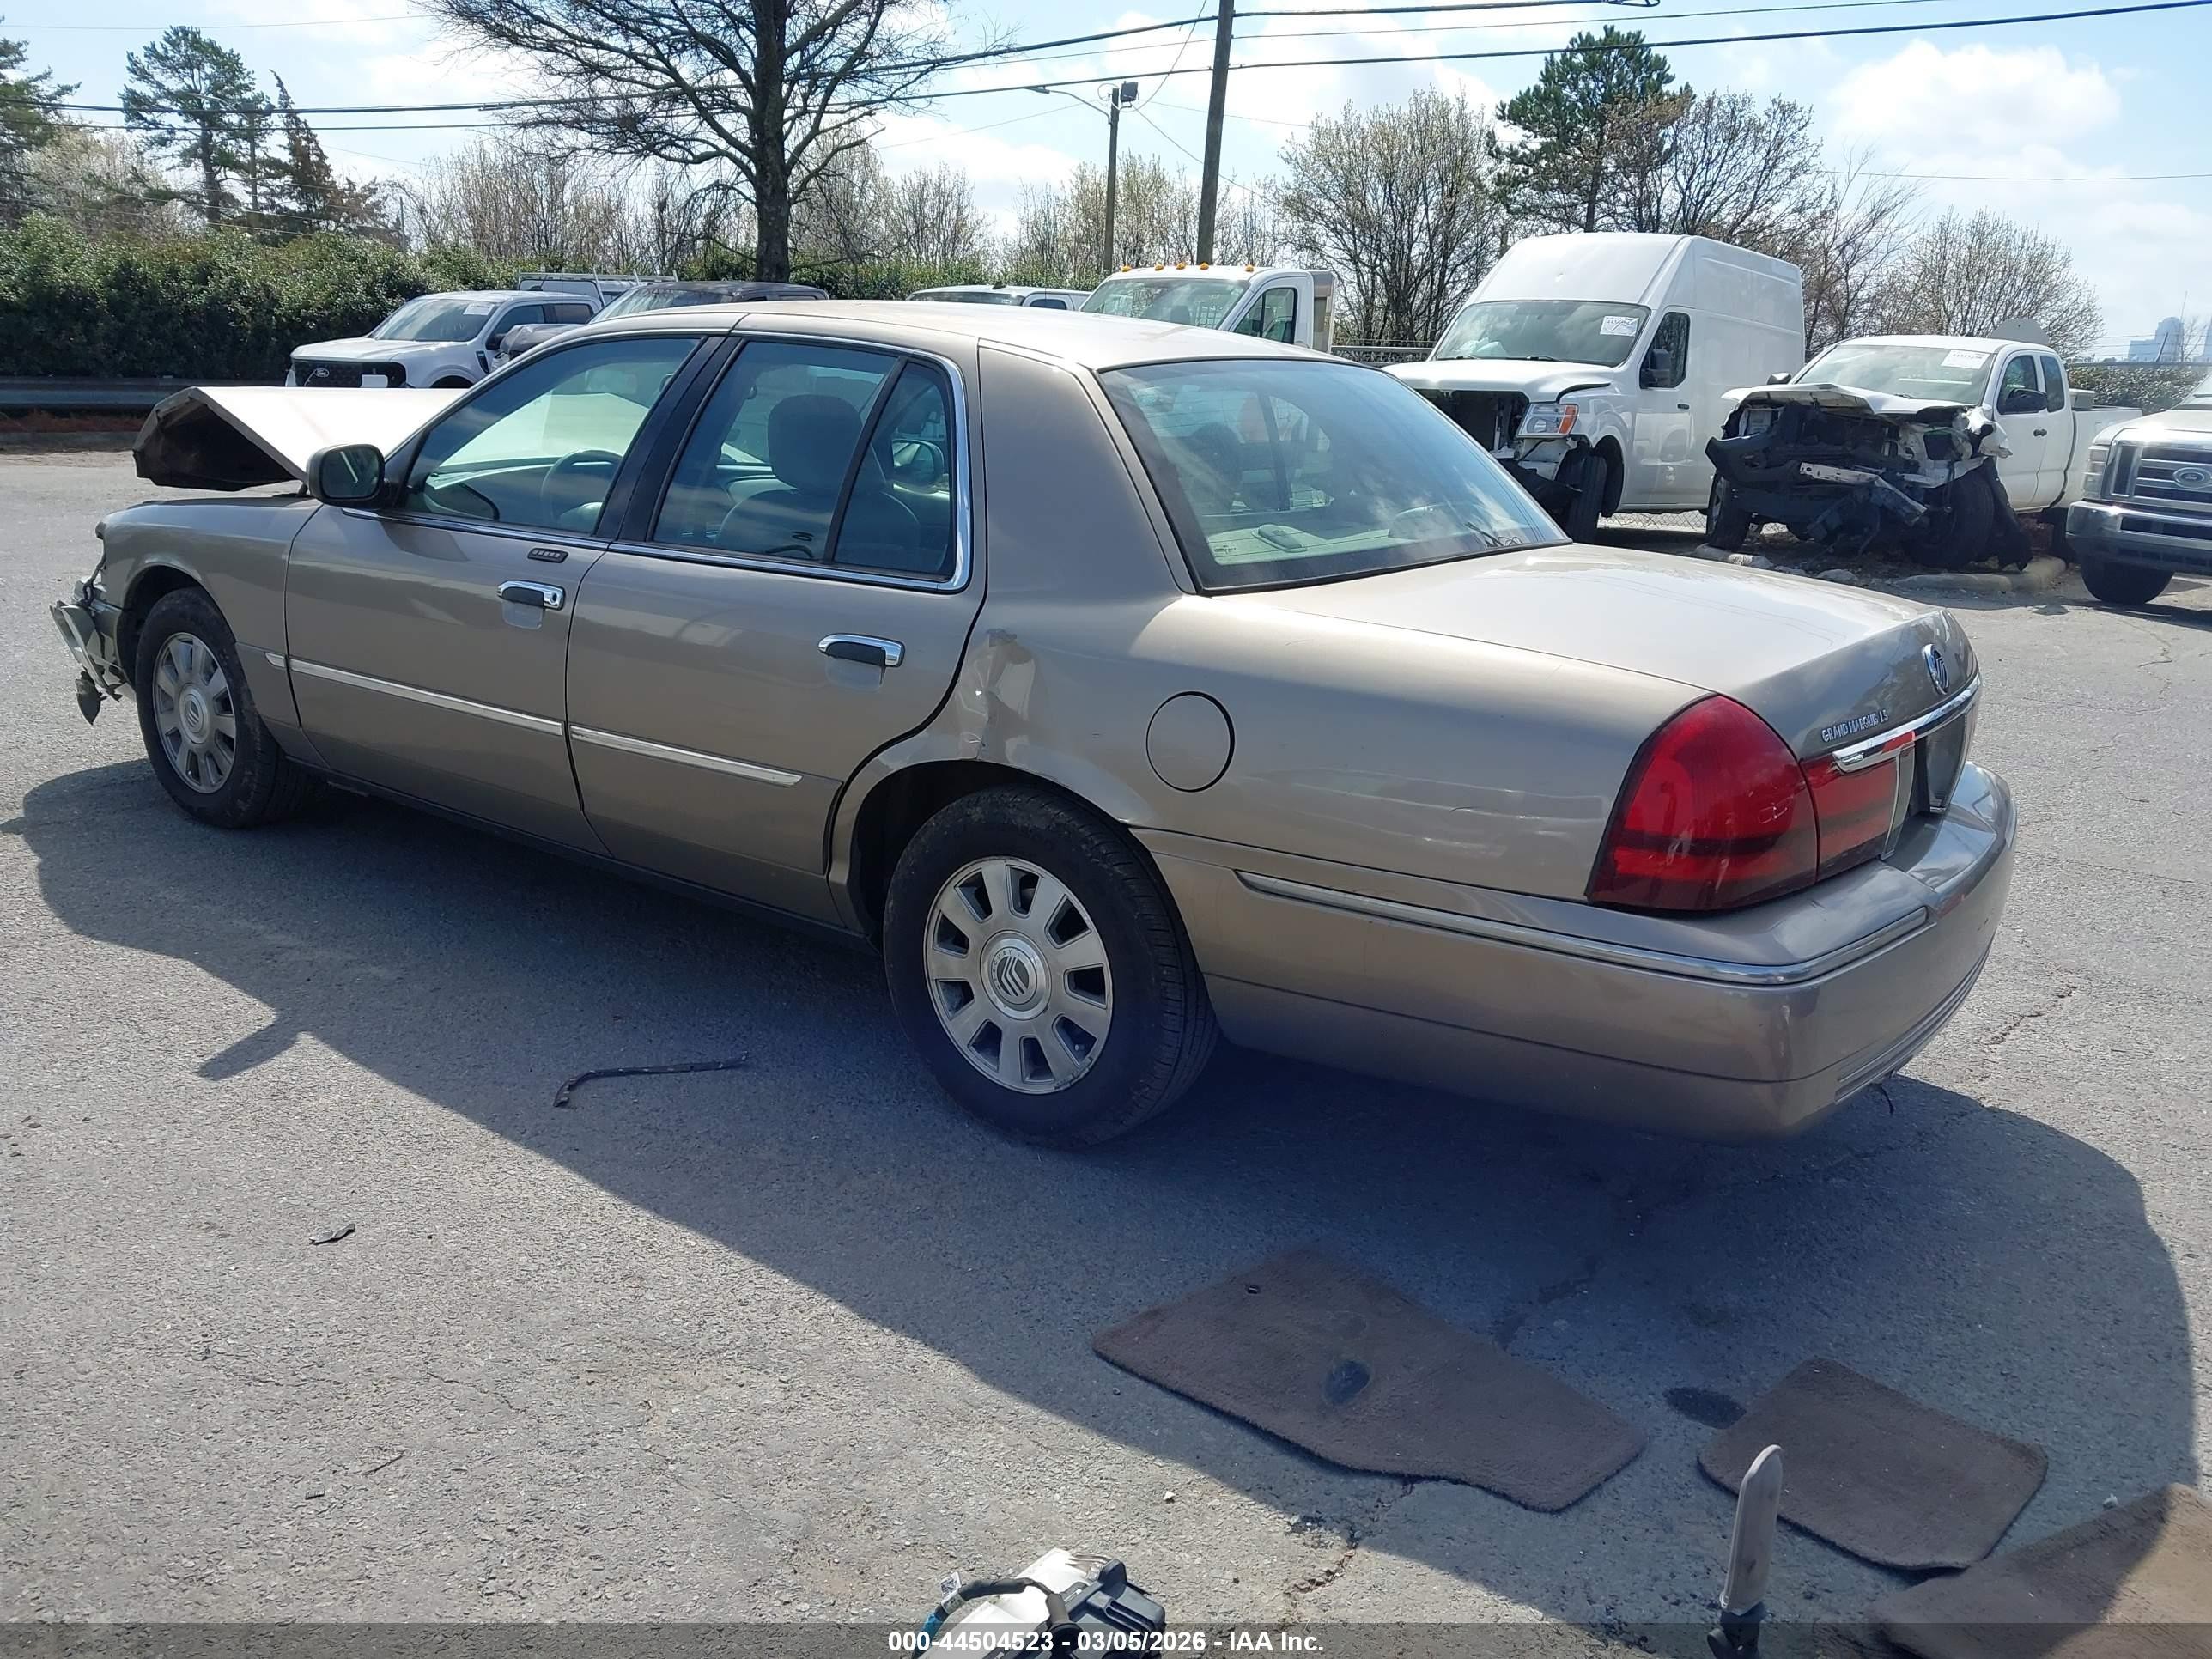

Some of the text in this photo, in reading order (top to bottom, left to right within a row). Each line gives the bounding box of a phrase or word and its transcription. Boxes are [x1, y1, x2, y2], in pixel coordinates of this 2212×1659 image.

[1821, 709, 1889, 743] GRAND MARQUIS LS
